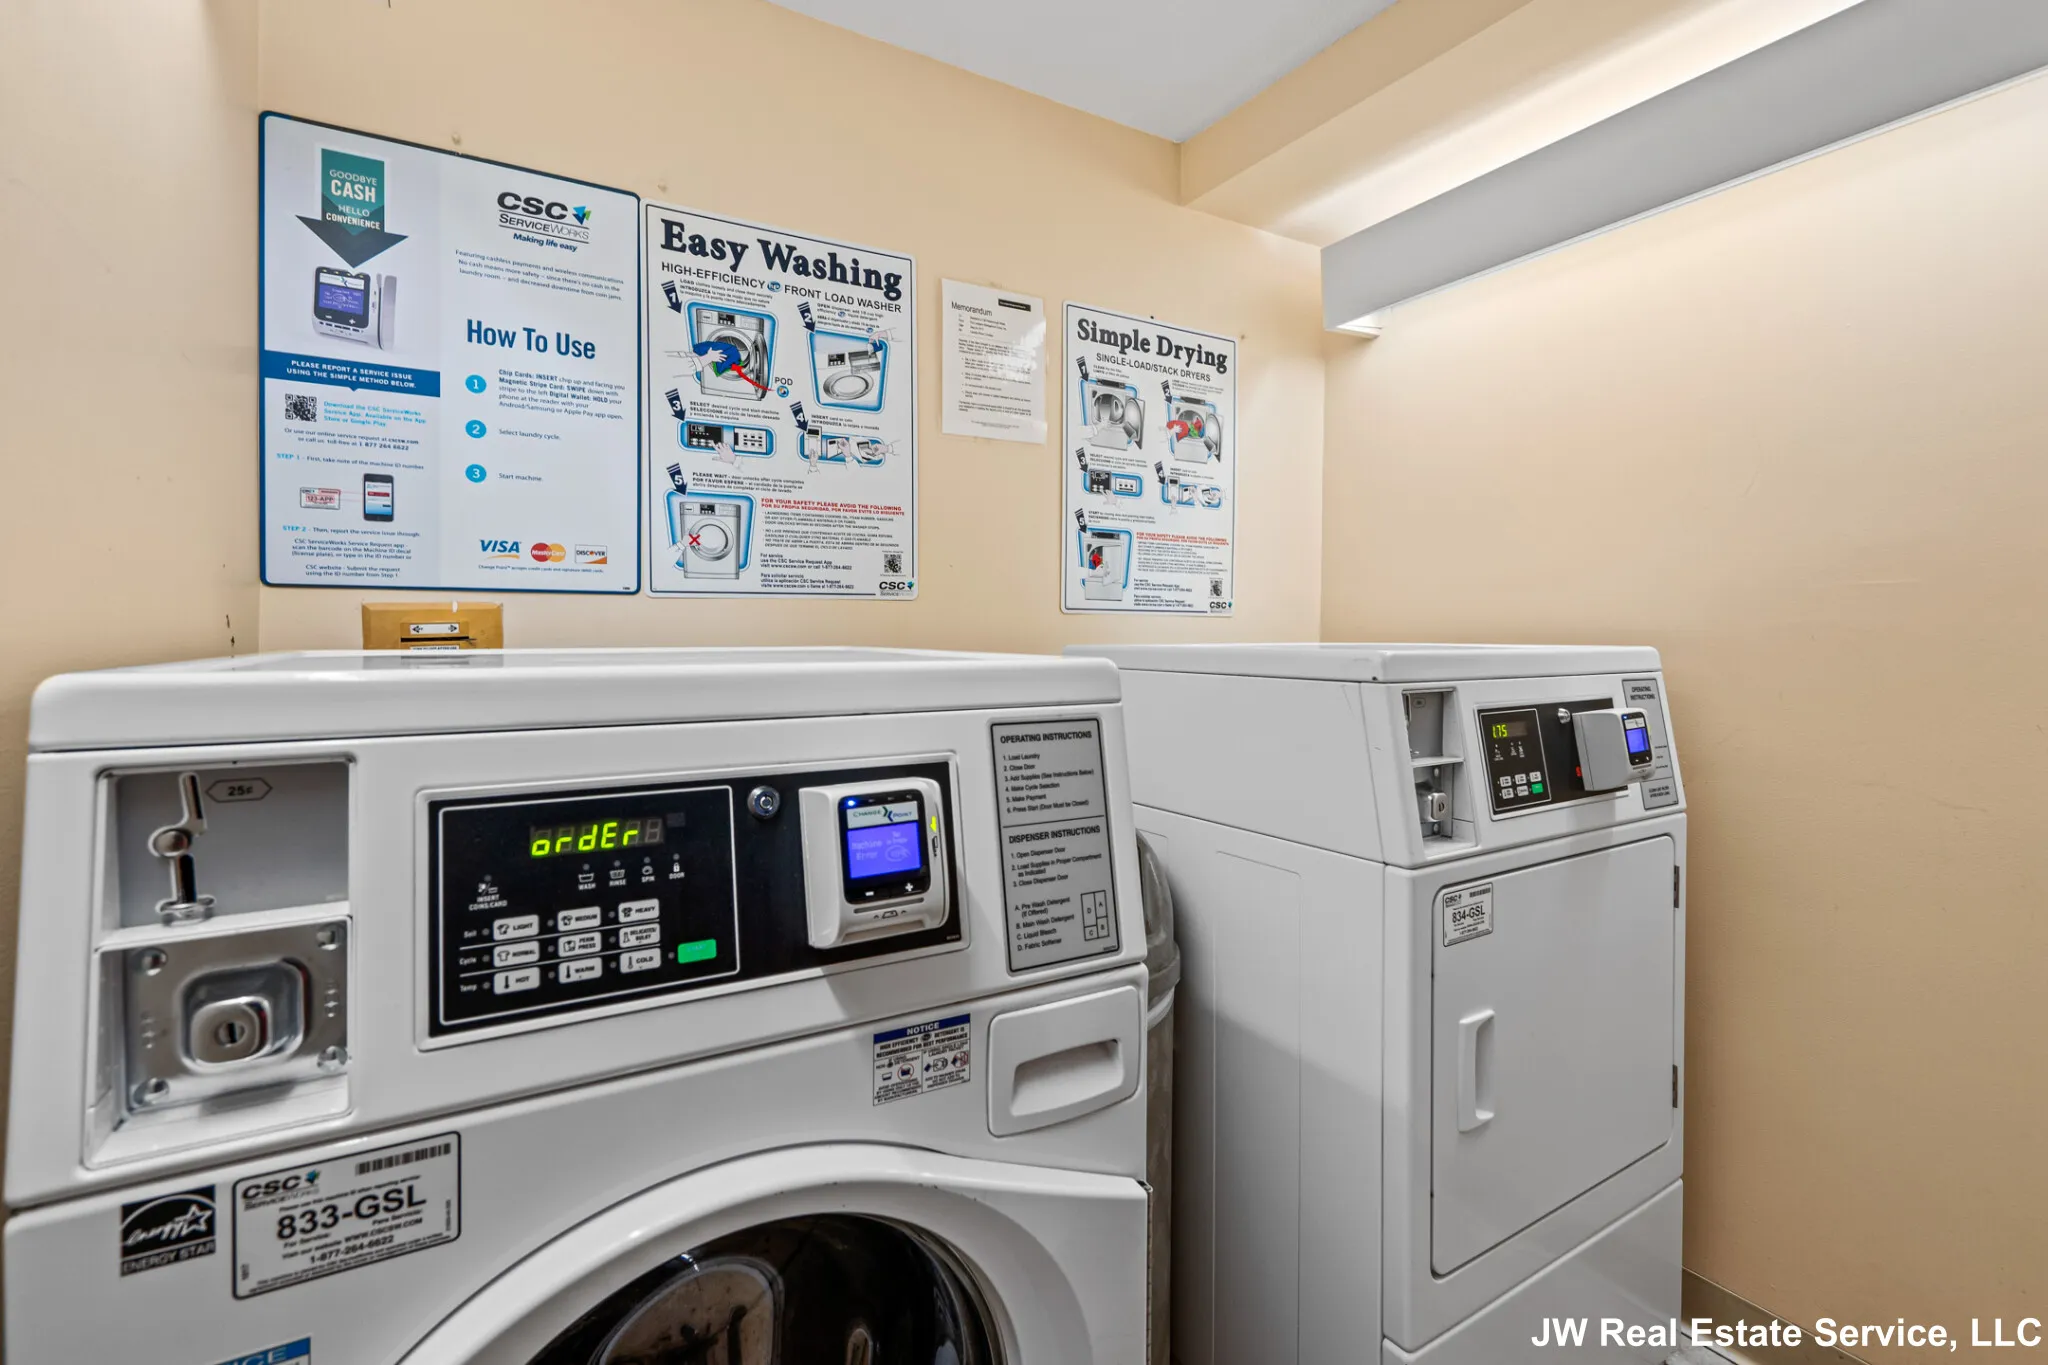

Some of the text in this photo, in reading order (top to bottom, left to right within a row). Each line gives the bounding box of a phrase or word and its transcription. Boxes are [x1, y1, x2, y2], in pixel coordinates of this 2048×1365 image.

[330, 169, 377, 185] GOODBYE
[331, 179, 375, 203] CASH
[338, 204, 370, 217] HELLO
[497, 192, 568, 220] CSC
[326, 213, 380, 230] CONVENIENCE
[513, 233, 577, 252] Making life easy
[660, 217, 903, 301] Easy Washing
[661, 261, 902, 313] HIGH-EFFICIENCY FRONT LOAD WASHER
[951, 301, 992, 317] Memorandum
[804, 313, 812, 323] 2
[467, 319, 596, 360] How To Use
[1078, 318, 1228, 374] Simple Drying
[292, 360, 320, 369] PLEASE
[322, 364, 350, 372] REPORT
[360, 369, 389, 377] SERVICE
[1097, 352, 1211, 382] SINGLE-LOAD/STACK DRYERS
[287, 368, 311, 376] USING
[330, 373, 356, 381] SIMPLE
[359, 376, 389, 385] METHOD
[391, 380, 416, 388] BELOW.
[473, 379, 478, 389] 1
[775, 377, 793, 386] POD
[550, 391, 568, 399] Digital
[673, 401, 681, 411] 3
[798, 412, 805, 422] 4
[472, 424, 480, 435] 2
[499, 428, 518, 436] Select
[519, 430, 543, 440] laundry
[472, 469, 480, 478] 3
[499, 472, 514, 480] Start
[675, 475, 682, 485] 5
[479, 539, 520, 553] VISA
[879, 582, 905, 590] CSC
[1000, 731, 1092, 744] OPERATING INSTRUCTIONS
[1009, 825, 1100, 844] DISPENSER INSTRUCTIONS
[1031, 849, 1053, 858] Dispenser
[476, 893, 500, 902] INSERT
[1047, 897, 1070, 906] Detergent
[635, 906, 655, 914] HEAVY
[1452, 905, 1485, 923] 834-GSL
[1051, 914, 1074, 924] Detergent
[464, 914, 597, 938] Soil LIGHT MEDIUM
[1025, 942, 1040, 950] Fabric
[574, 965, 595, 974] WARM
[636, 956, 653, 964] COLD
[907, 1022, 940, 1035] NOTICE
[242, 1175, 302, 1200] CSC
[277, 1185, 427, 1240] 833-GSL
[124, 1250, 177, 1272] ENERGY
